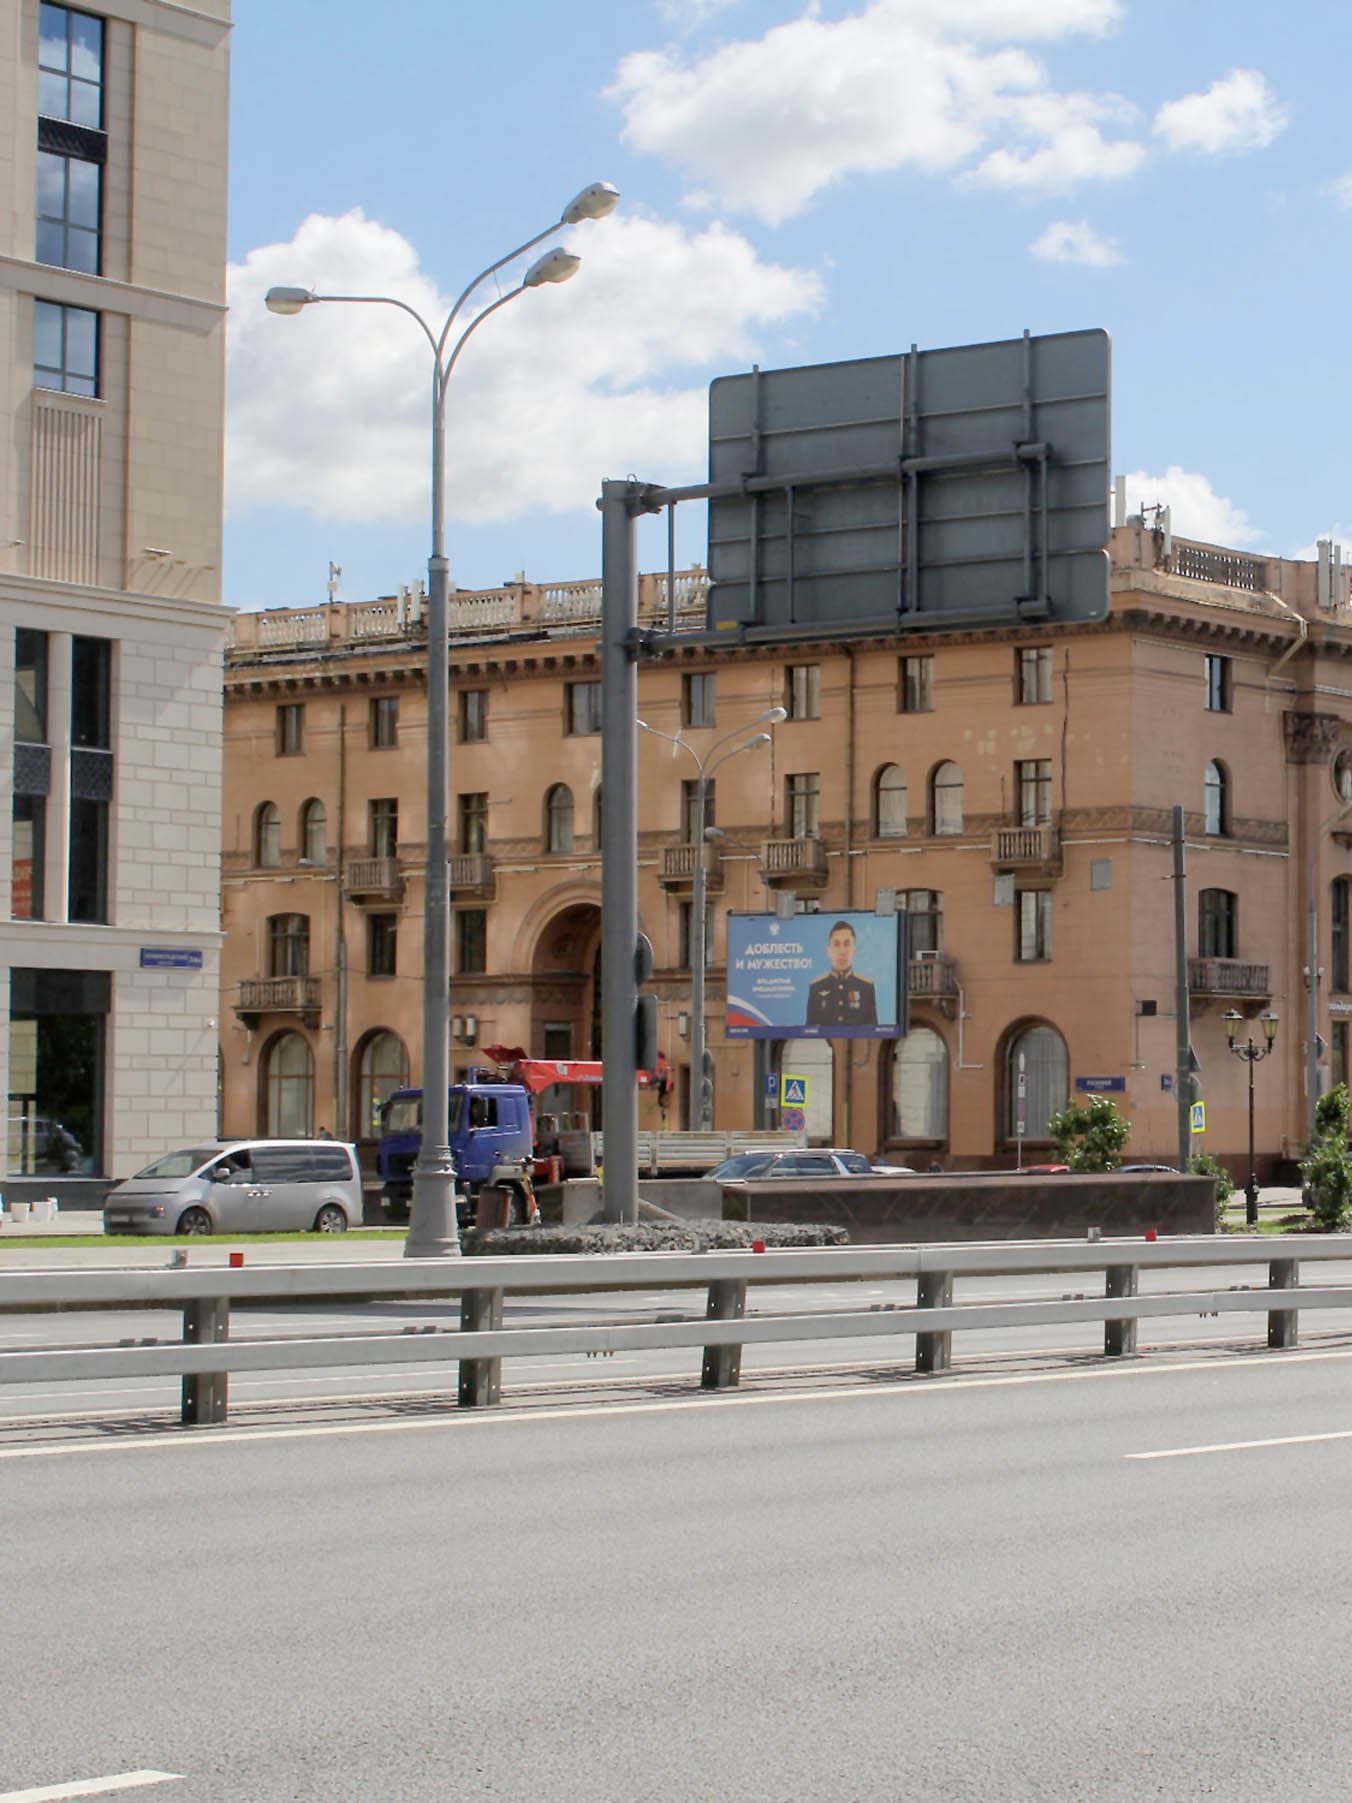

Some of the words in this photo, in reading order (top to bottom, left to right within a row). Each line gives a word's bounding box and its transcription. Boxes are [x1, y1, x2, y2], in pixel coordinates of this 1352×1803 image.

[745, 943, 804, 955] ДОБЛЕСТЬ
[735, 959, 744, 969] И
[747, 958, 812, 969] МУЖЕСТВО!
